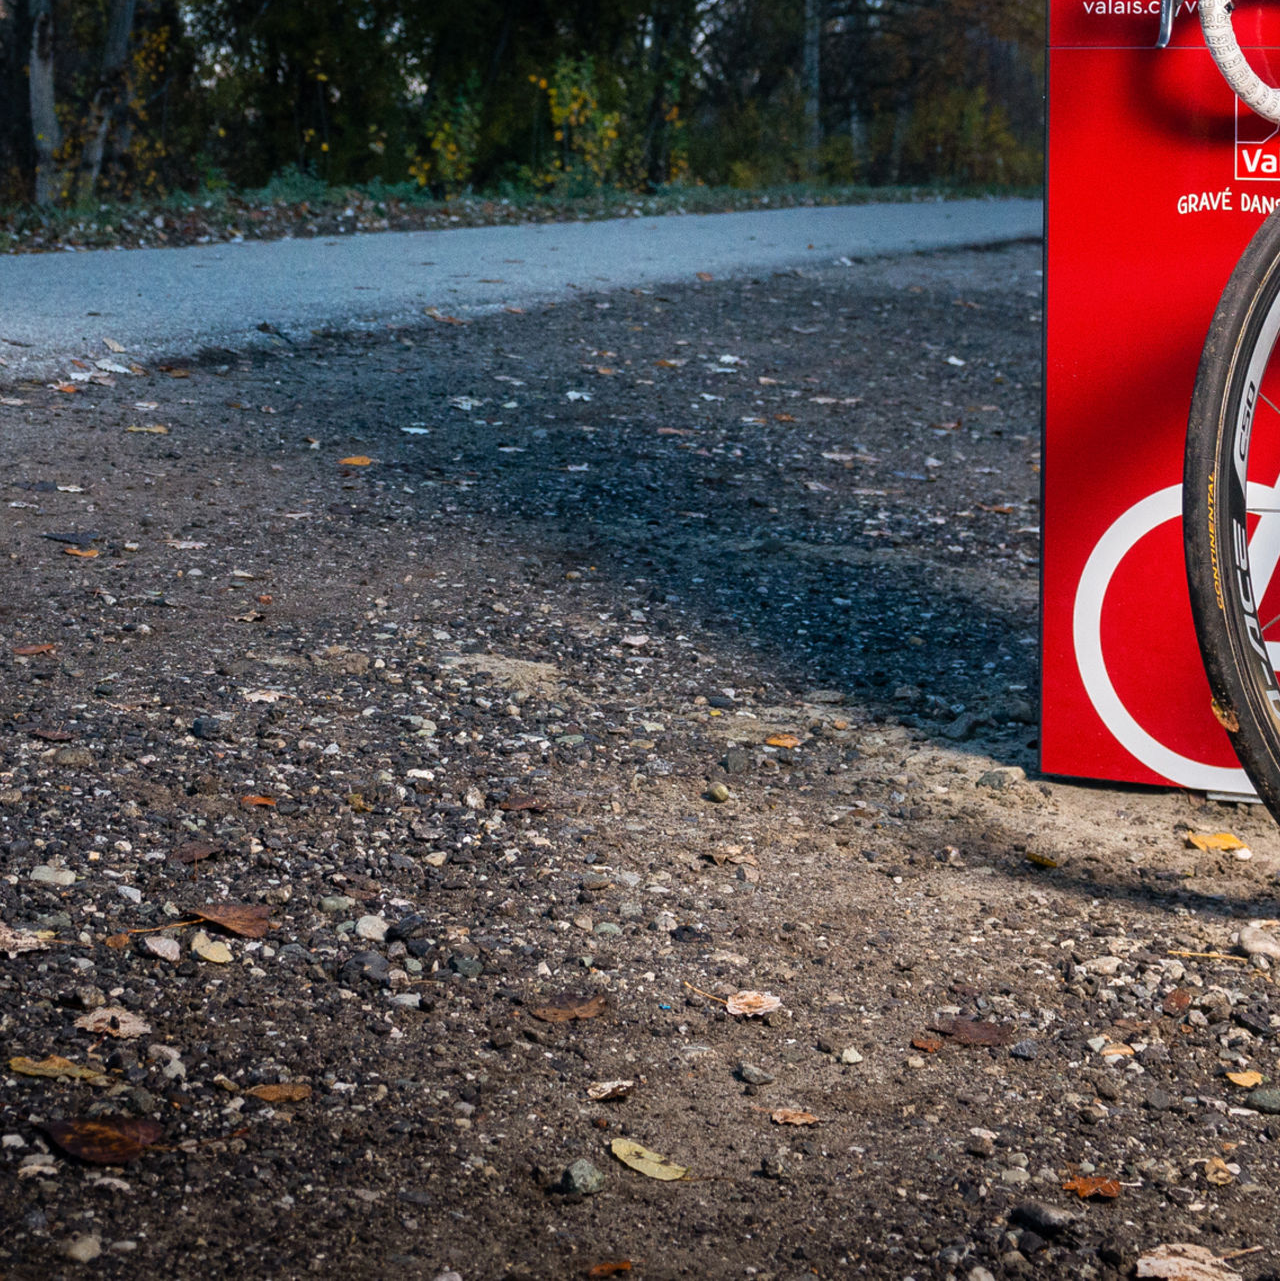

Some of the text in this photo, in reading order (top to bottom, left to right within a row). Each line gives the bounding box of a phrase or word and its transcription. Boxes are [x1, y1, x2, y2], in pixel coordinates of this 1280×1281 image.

[1177, 187, 1233, 215] GRAVÉ
[1239, 380, 1256, 462] C50
[1206, 471, 1226, 611] CONTINENTAL
